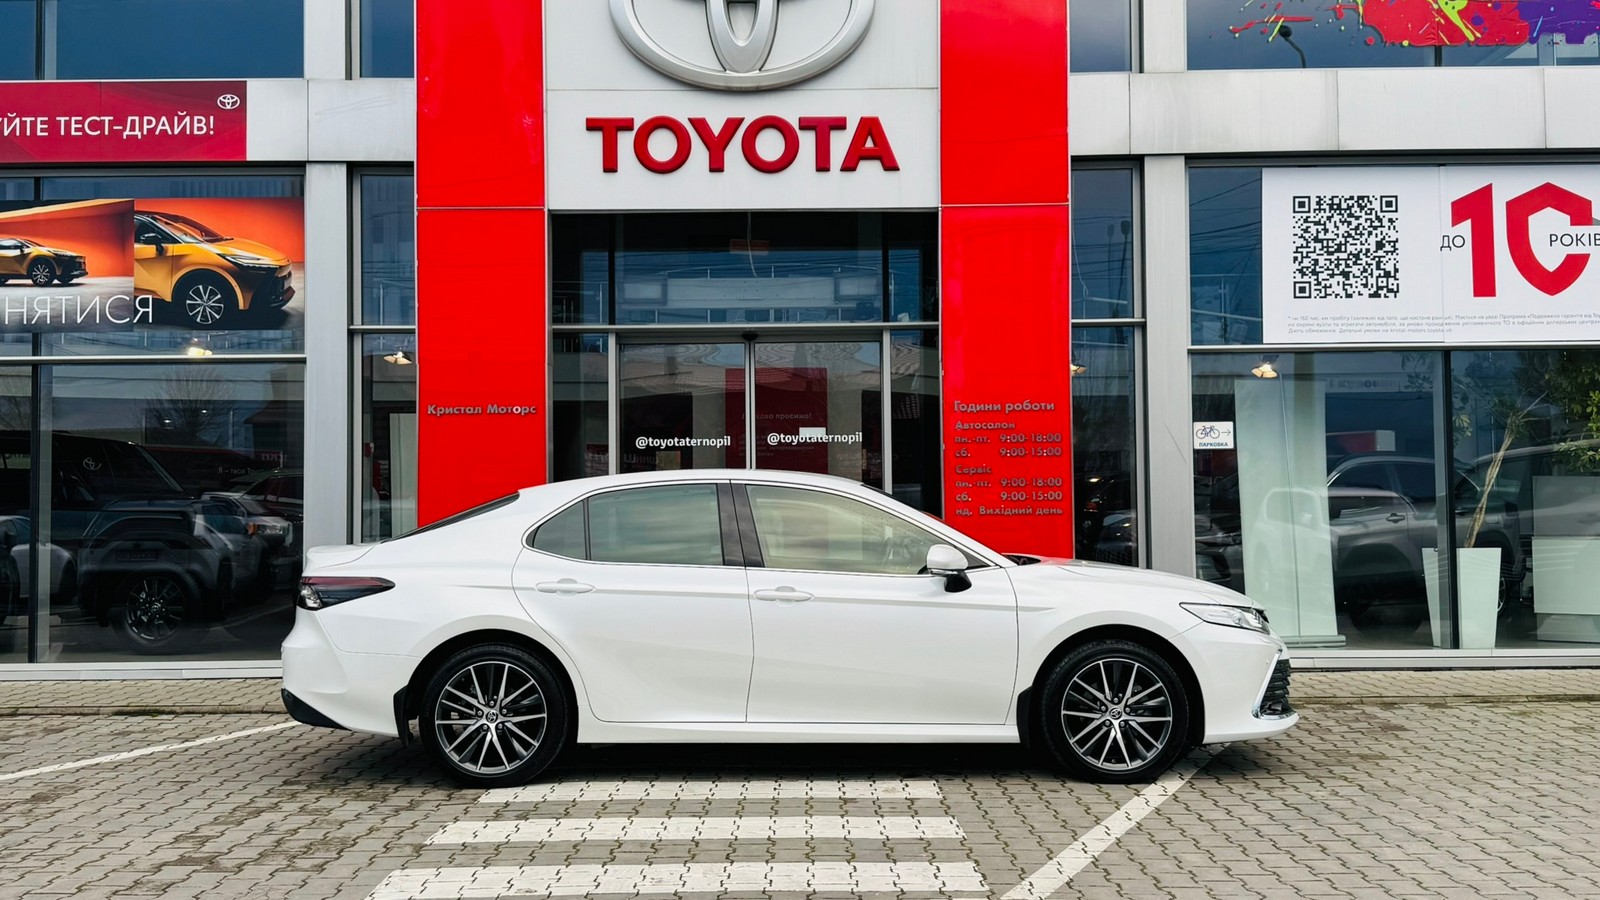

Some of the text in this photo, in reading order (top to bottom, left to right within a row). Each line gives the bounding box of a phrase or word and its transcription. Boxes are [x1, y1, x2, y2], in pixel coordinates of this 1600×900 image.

[0, 111, 215, 139] ЙТЕ ТЕСТ-ДРАЙВ!
[586, 115, 901, 174] TOYOTA
[1440, 234, 1466, 251] ДО
[4, 294, 153, 325] НЯТИСЯ
[427, 404, 536, 416] Кристал Моторс
[954, 400, 1055, 413] Години роботи
[955, 421, 1016, 430] Автосалон
[635, 435, 731, 449] @toyotaternopil
[767, 431, 863, 446] @toyotaternopil
[955, 447, 971, 457] сб.
[955, 463, 992, 475] Сервіс
[955, 492, 972, 502] сб.
[955, 505, 1063, 516] нд. Вихідний день
